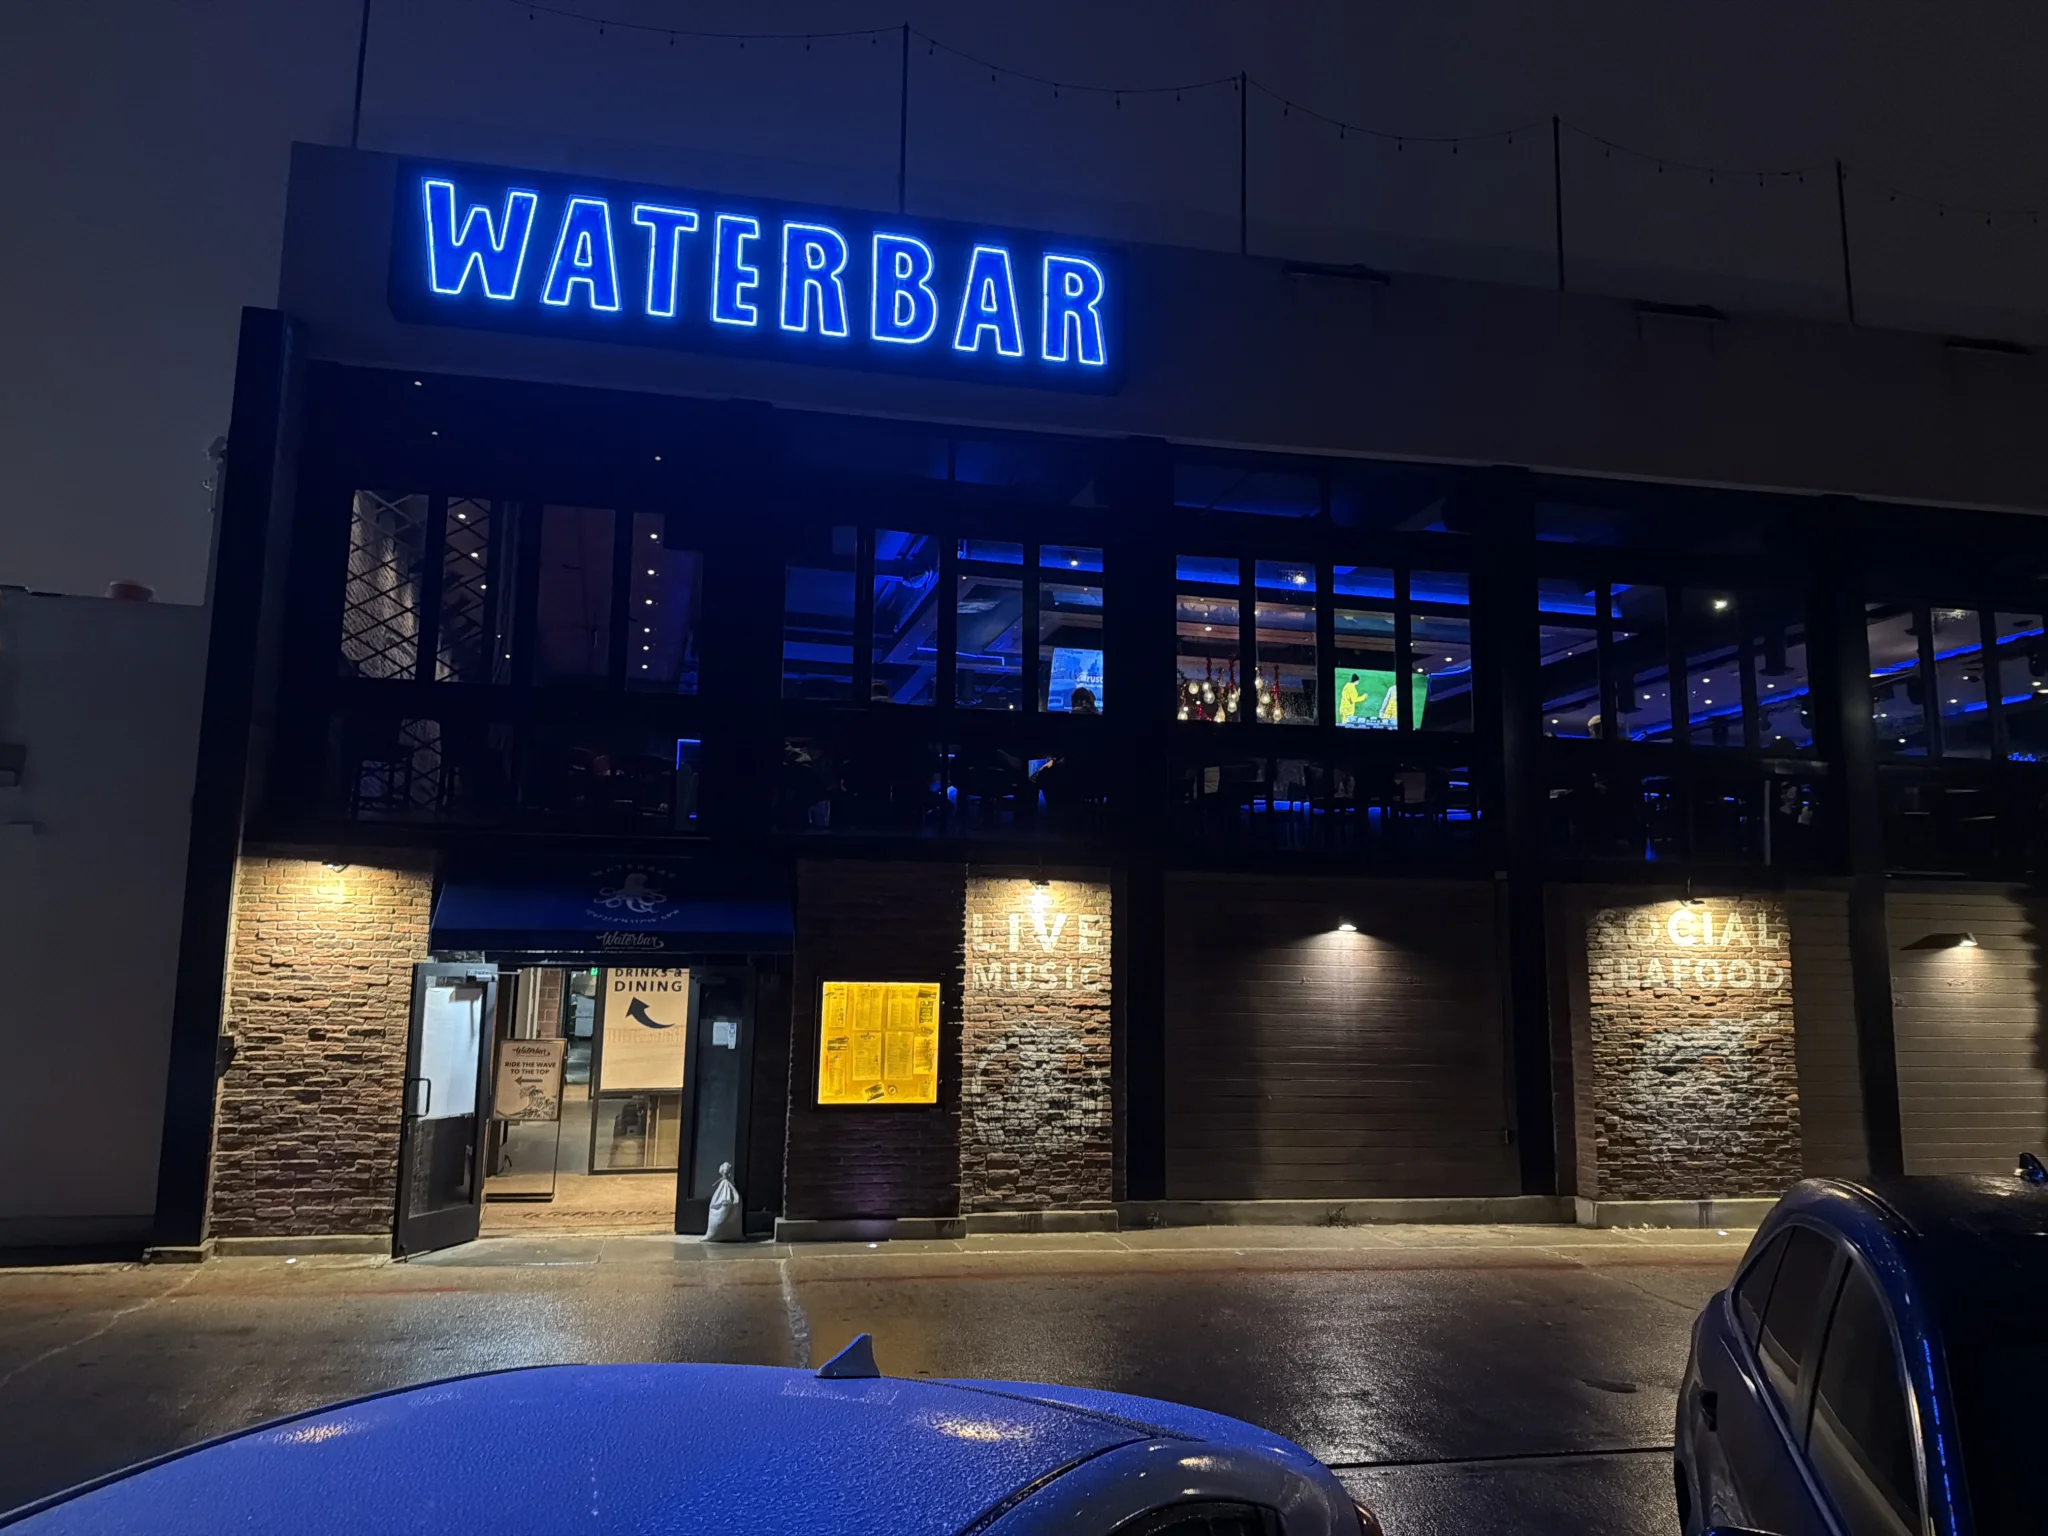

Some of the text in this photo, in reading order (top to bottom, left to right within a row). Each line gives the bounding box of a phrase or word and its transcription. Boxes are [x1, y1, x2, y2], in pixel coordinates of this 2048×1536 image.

[421, 176, 1107, 366] WATERBAR
[596, 931, 665, 951] Waterbar
[972, 912, 1104, 953] LIVE
[1595, 906, 1780, 947] SOCIAL
[614, 968, 667, 978] DRINKS
[614, 980, 683, 992] DINING
[972, 962, 1104, 991] MUSIC
